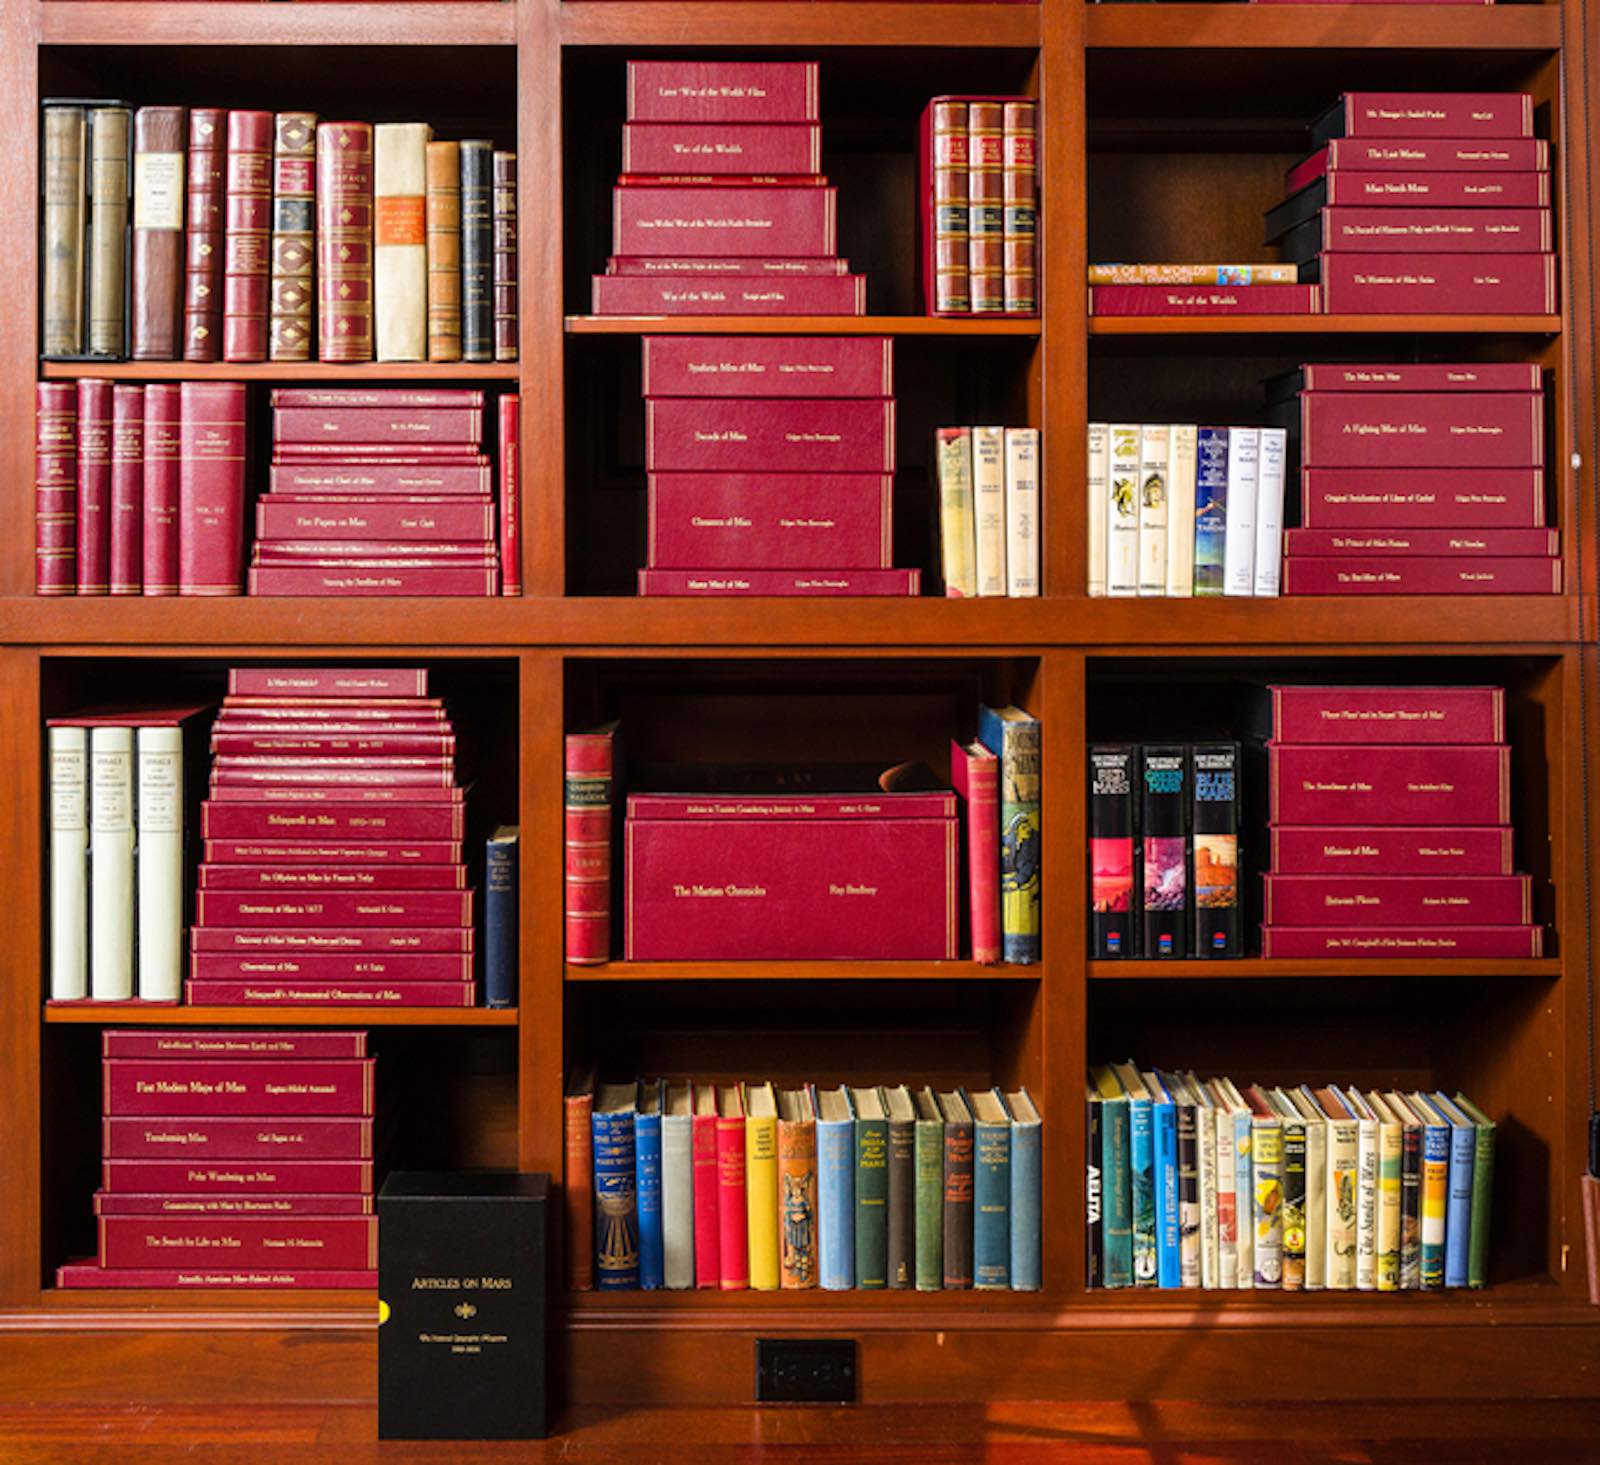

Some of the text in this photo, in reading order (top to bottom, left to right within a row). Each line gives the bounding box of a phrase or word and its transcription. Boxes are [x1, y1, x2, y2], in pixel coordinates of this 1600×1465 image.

[692, 144, 701, 153] of
[702, 144, 713, 153] the
[1186, 296, 1195, 305] of
[1196, 296, 1207, 305] the
[673, 885, 766, 897] The Martian Chronicles
[214, 1082, 224, 1093] of
[225, 1082, 247, 1093] Mars
